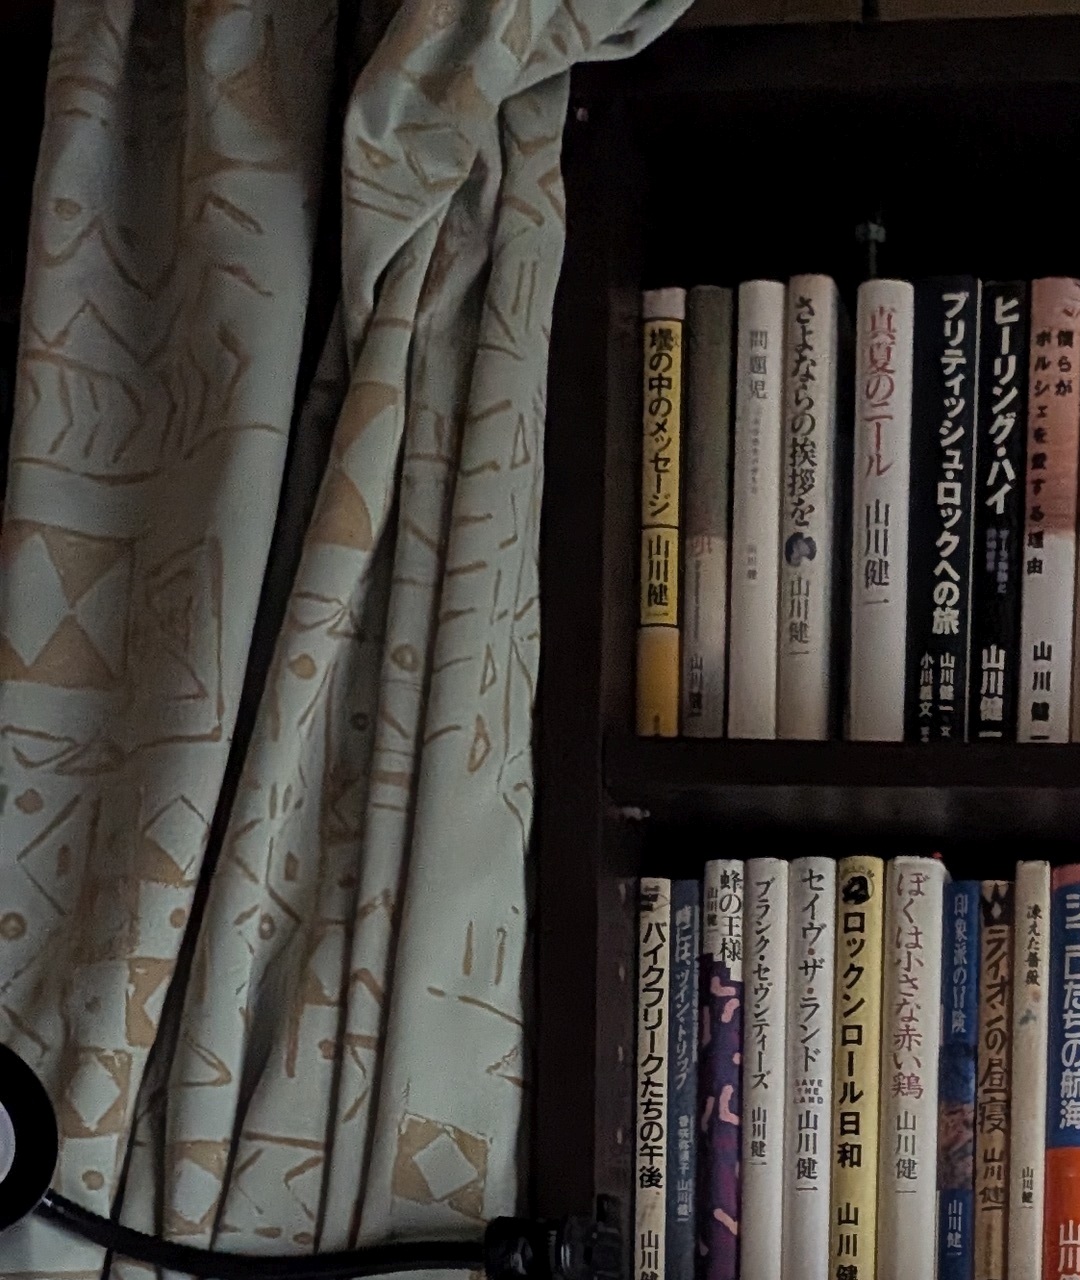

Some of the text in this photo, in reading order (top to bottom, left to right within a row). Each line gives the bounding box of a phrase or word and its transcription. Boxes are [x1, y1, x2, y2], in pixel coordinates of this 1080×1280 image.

[750, 330, 767, 398] 問題児
[789, 296, 817, 526] さよならの挨拶を
[864, 306, 895, 478] 真夏のニール
[985, 296, 1018, 515] ヒーリング・ハイ
[865, 499, 889, 606] 山川健一
[932, 292, 969, 635] ブリティッシュ・ロックへの旅
[719, 870, 743, 962] 蜂の王様
[798, 869, 826, 1072] セイヴ・ザ・ランド
[892, 872, 925, 1100] ぼくは小さな赤い鶏
[638, 921, 667, 1188] バイクフリークたちの午後
[836, 913, 867, 1169] ロックンロール日和
[750, 1107, 767, 1168] 山川健一
[795, 1110, 819, 1192] 山川健一
[894, 1110, 917, 1194] 山川健一
